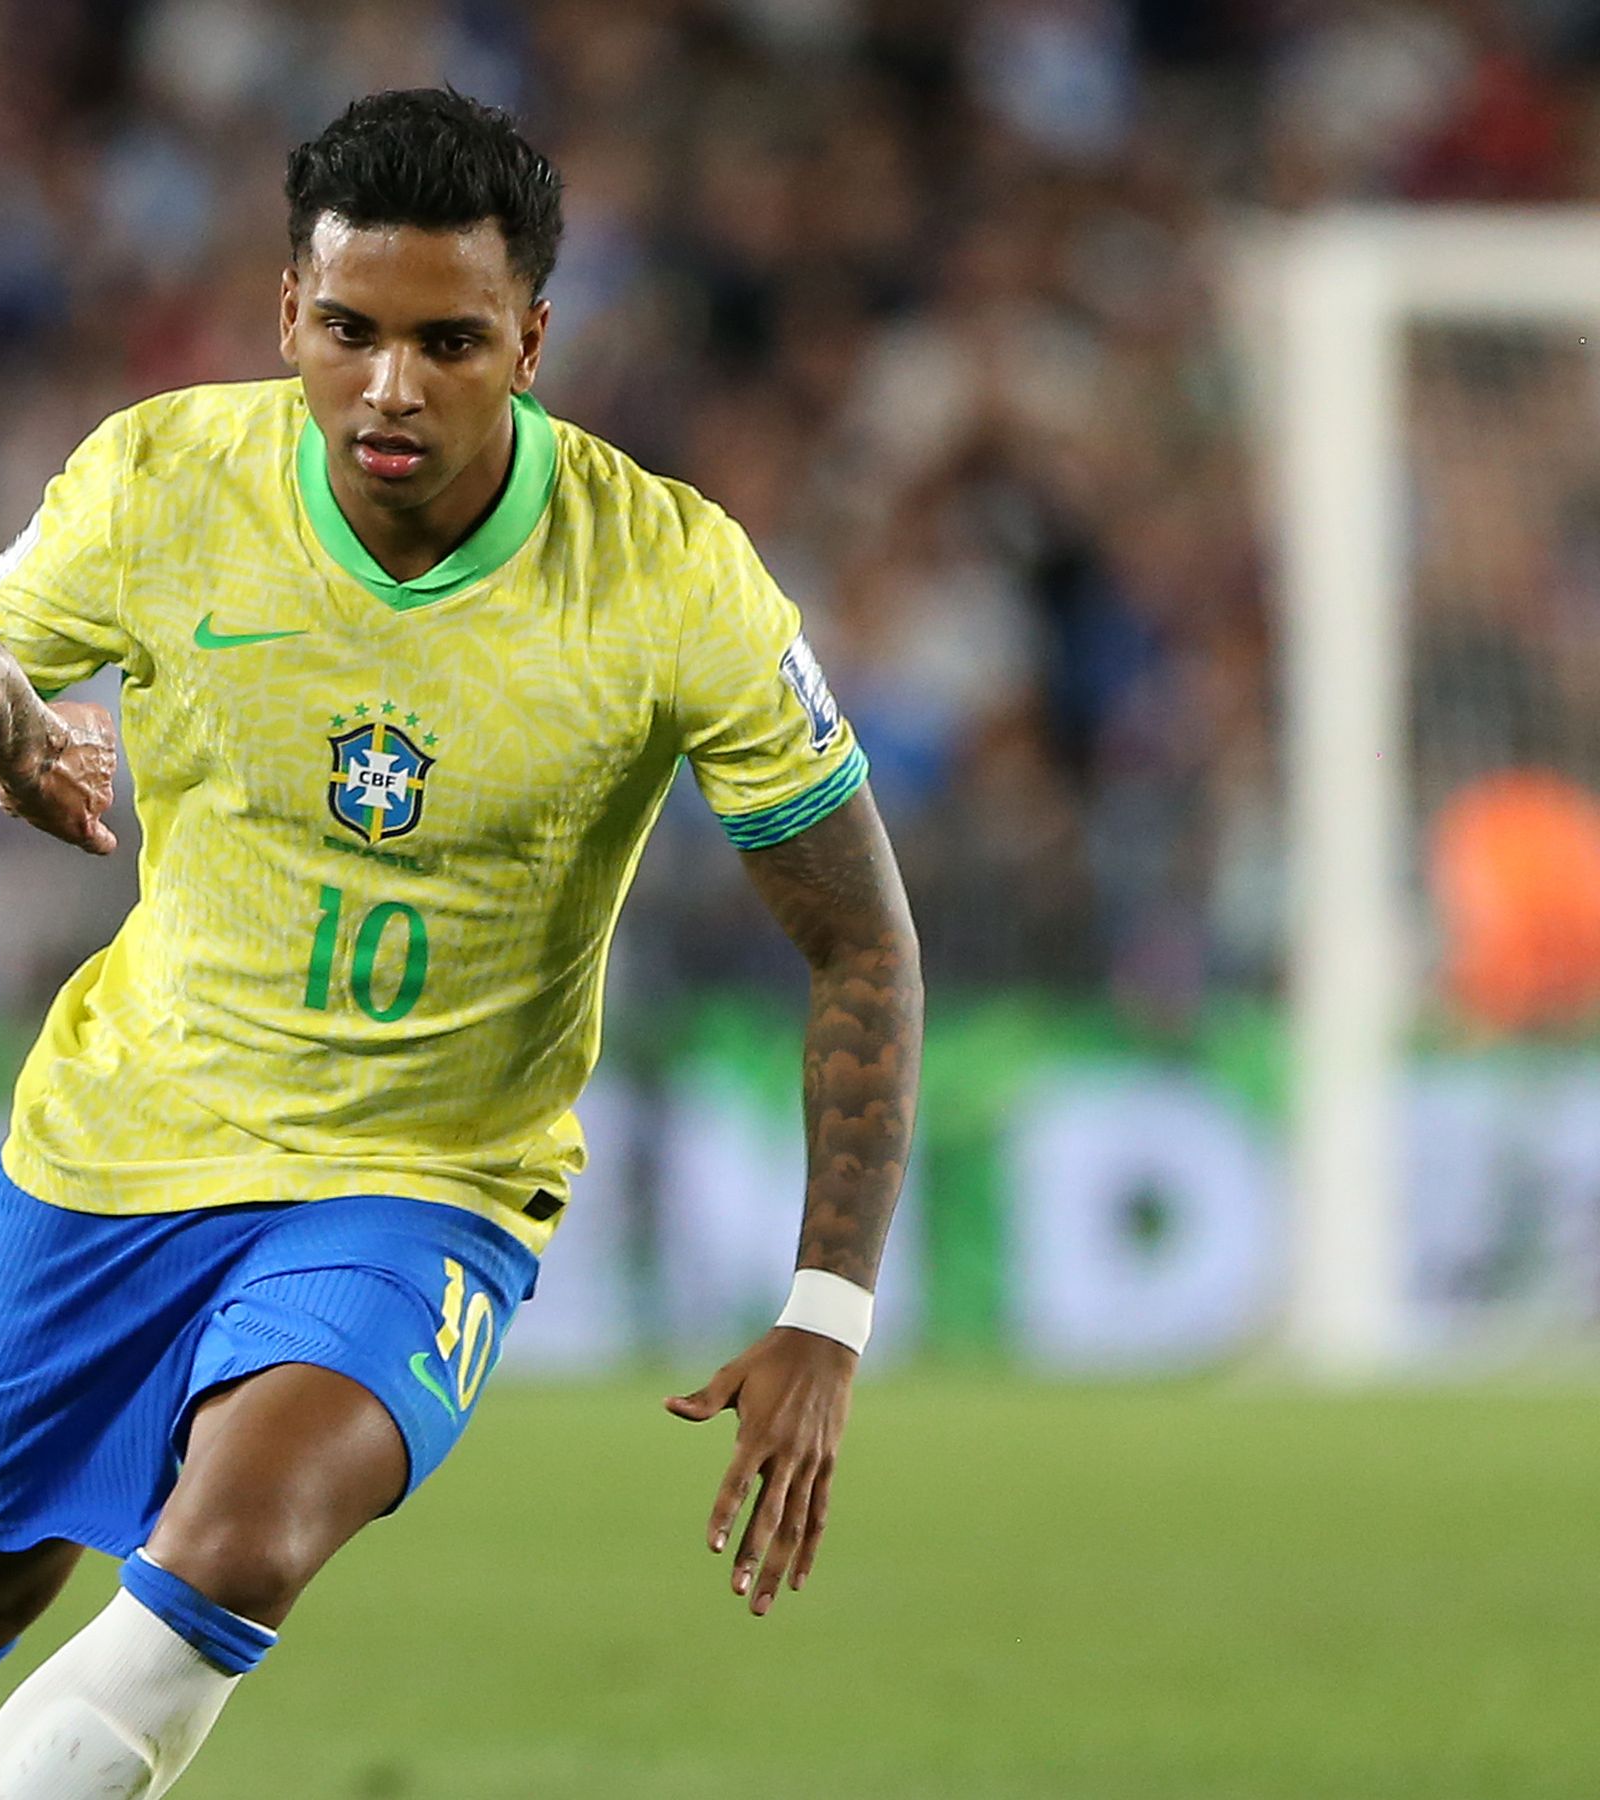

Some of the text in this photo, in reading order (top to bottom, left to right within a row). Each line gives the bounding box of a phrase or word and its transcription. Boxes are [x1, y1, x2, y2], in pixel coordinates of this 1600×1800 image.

[358, 770, 397, 789] CBF
[304, 884, 429, 1024] 10
[435, 1257, 494, 1412] 10
